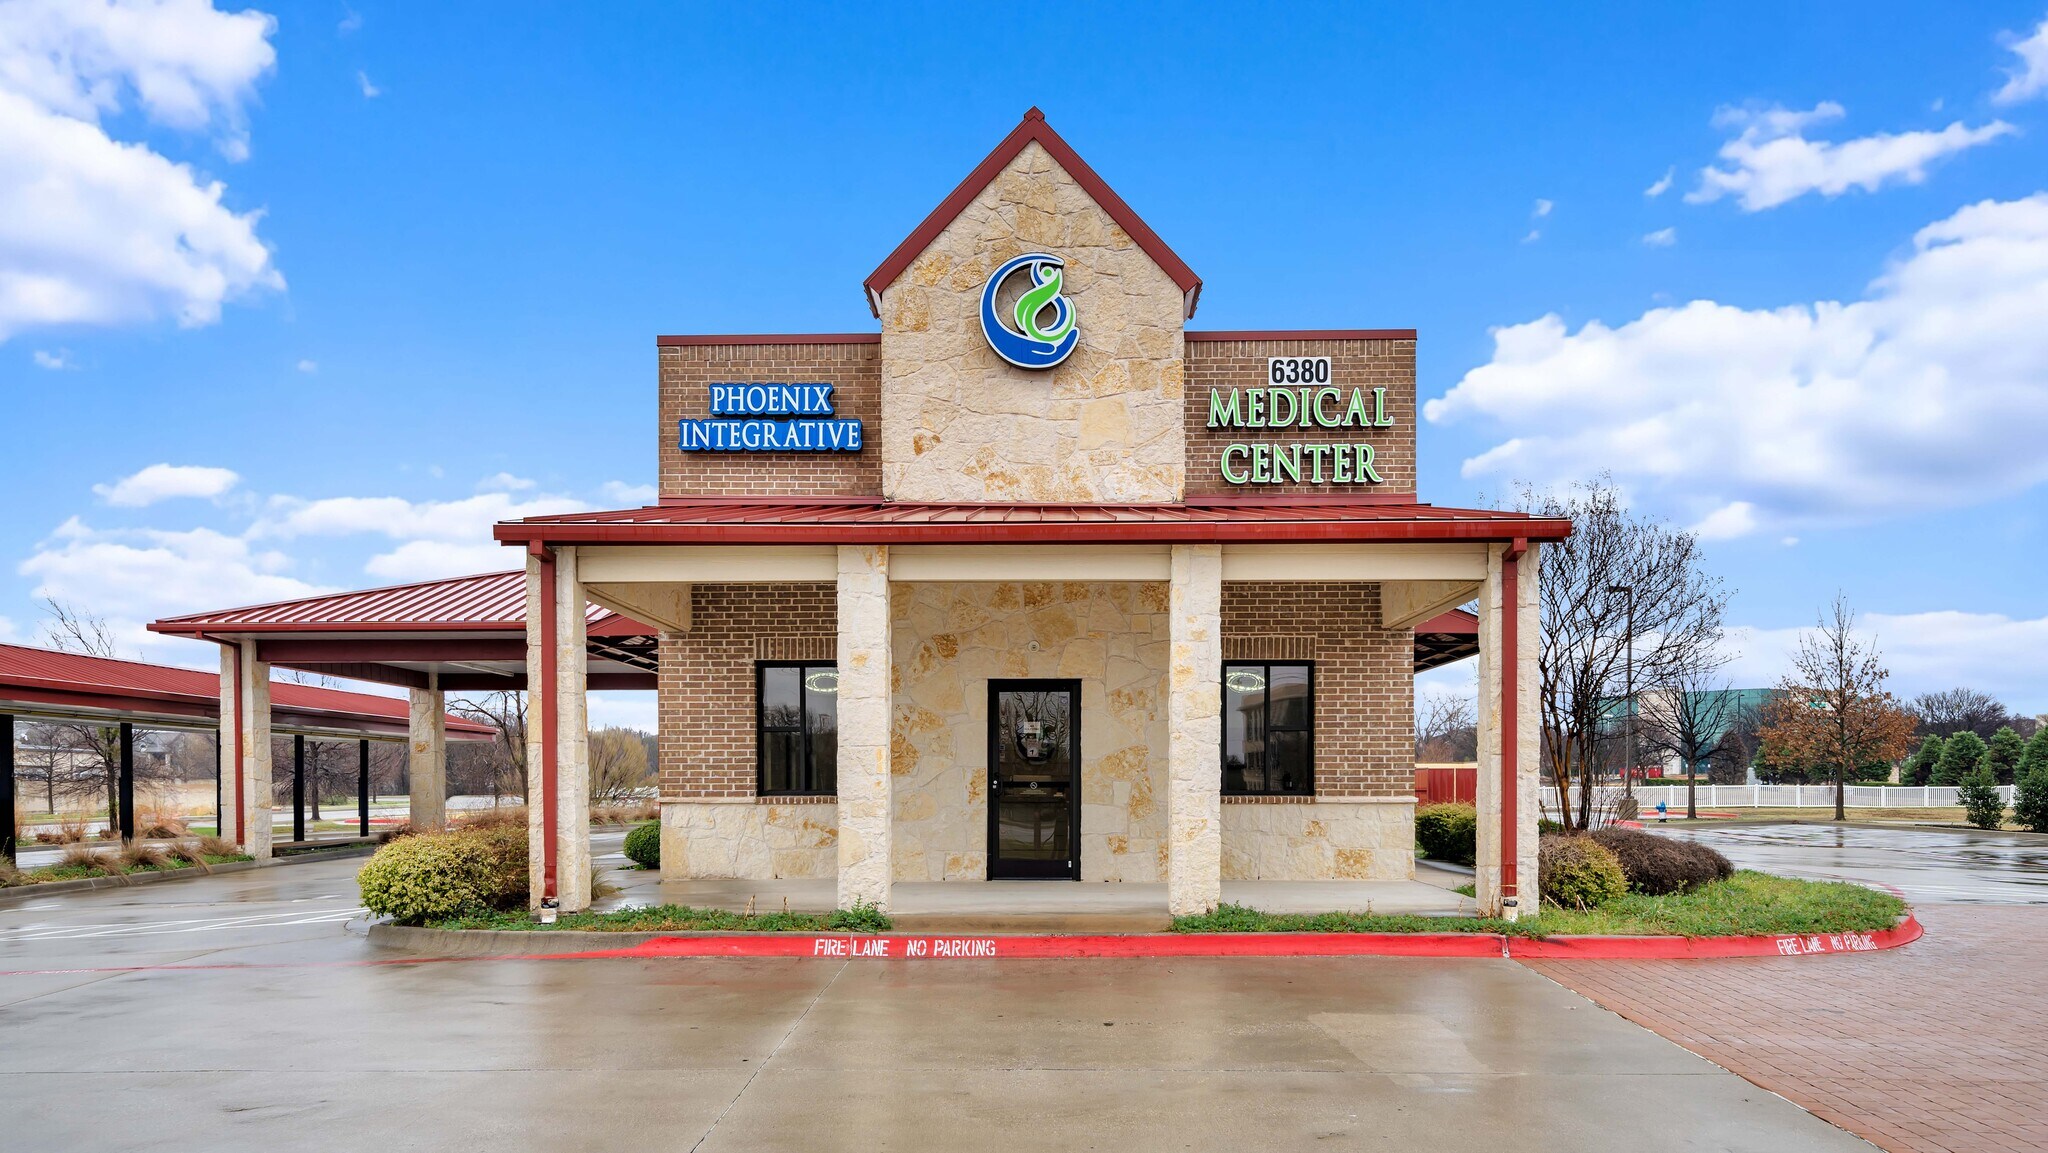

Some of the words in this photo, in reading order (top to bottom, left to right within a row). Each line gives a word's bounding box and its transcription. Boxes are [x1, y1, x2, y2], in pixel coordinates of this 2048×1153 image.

[1271, 359, 1329, 383] 6380
[712, 386, 831, 412] PHOENIX
[1207, 387, 1394, 427] MEDICAL
[681, 422, 860, 447] INTEGRATIVE
[1220, 443, 1384, 484] CENTER
[814, 938, 847, 956] FIRE
[852, 939, 890, 957] LANE
[906, 939, 927, 957] NO
[933, 939, 996, 957] PARKING
[1776, 938, 1801, 955] FIRE
[1799, 936, 1825, 953] LANE
[1830, 935, 1843, 950] NO
